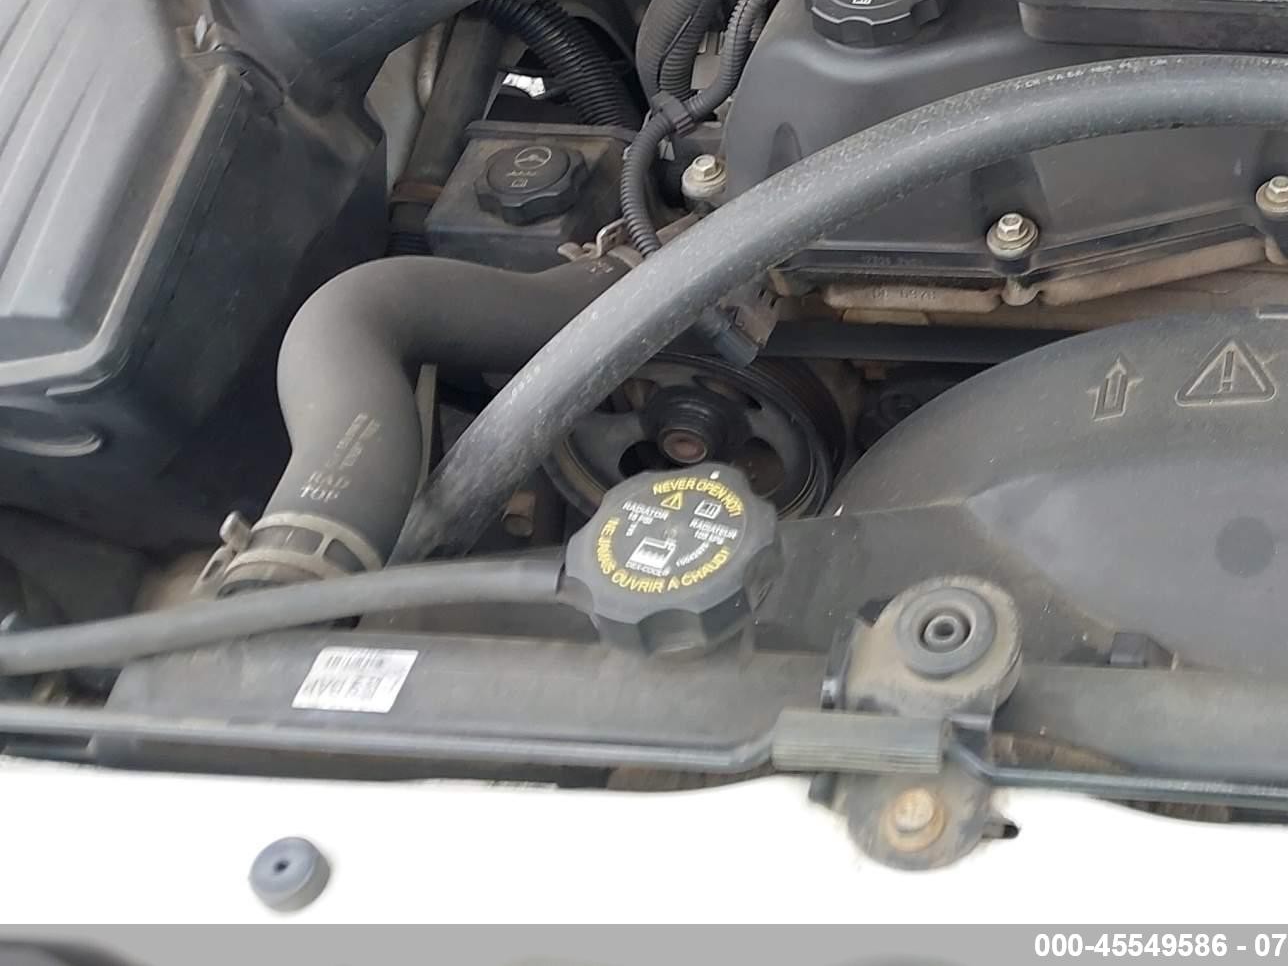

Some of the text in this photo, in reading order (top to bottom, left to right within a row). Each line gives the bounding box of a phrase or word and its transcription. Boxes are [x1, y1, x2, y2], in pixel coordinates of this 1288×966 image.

[622, 500, 670, 521] RADIATOR
[652, 478, 746, 518] NEVER OPEN HOT!
[689, 517, 738, 540] RADIATEUR
[611, 569, 666, 594] OUVRIR
[680, 547, 731, 587] CHAUD!
